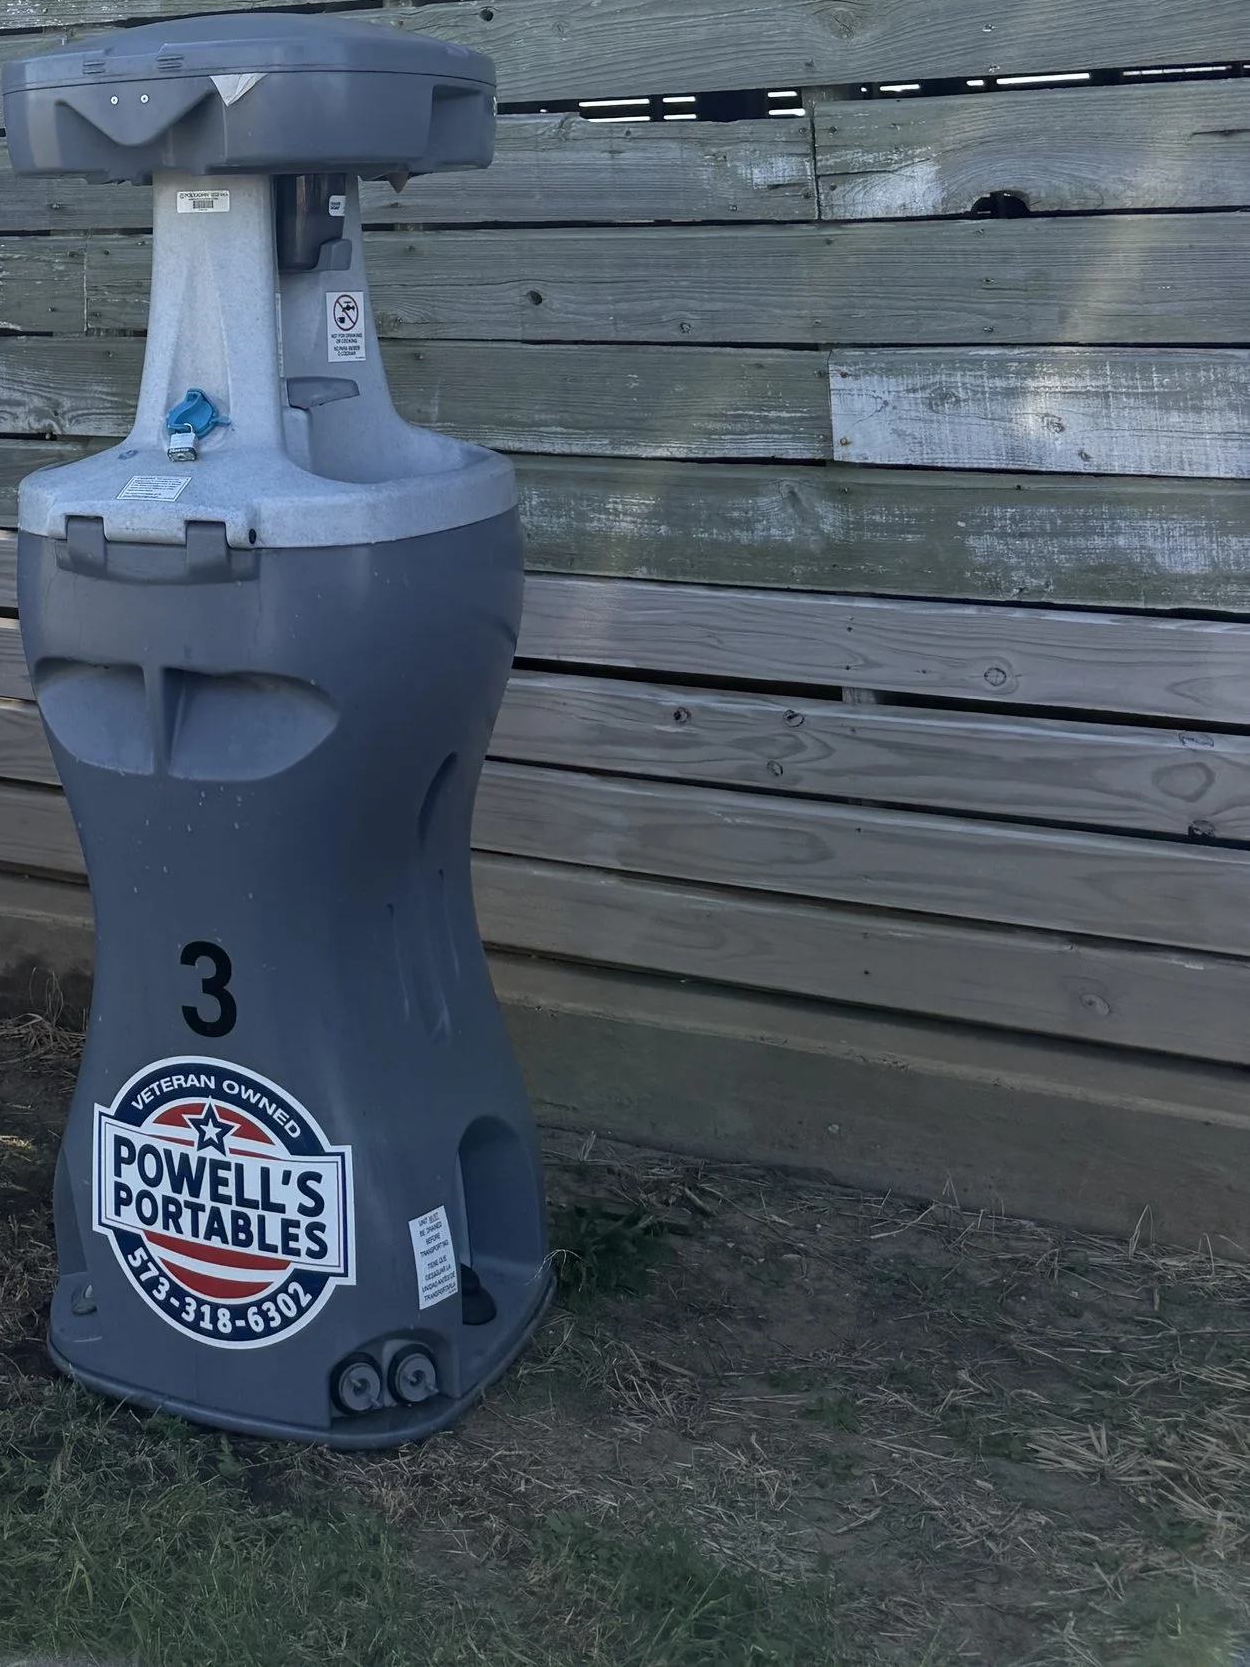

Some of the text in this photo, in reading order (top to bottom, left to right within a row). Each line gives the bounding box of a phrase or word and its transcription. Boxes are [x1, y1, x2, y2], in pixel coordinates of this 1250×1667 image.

[179, 940, 238, 1038] 3
[131, 1074, 301, 1139] VETERAN OWNED
[113, 1134, 326, 1218] POWELL'S
[113, 1180, 328, 1260] PORTABLES
[127, 1247, 312, 1334] 573-318-6302
